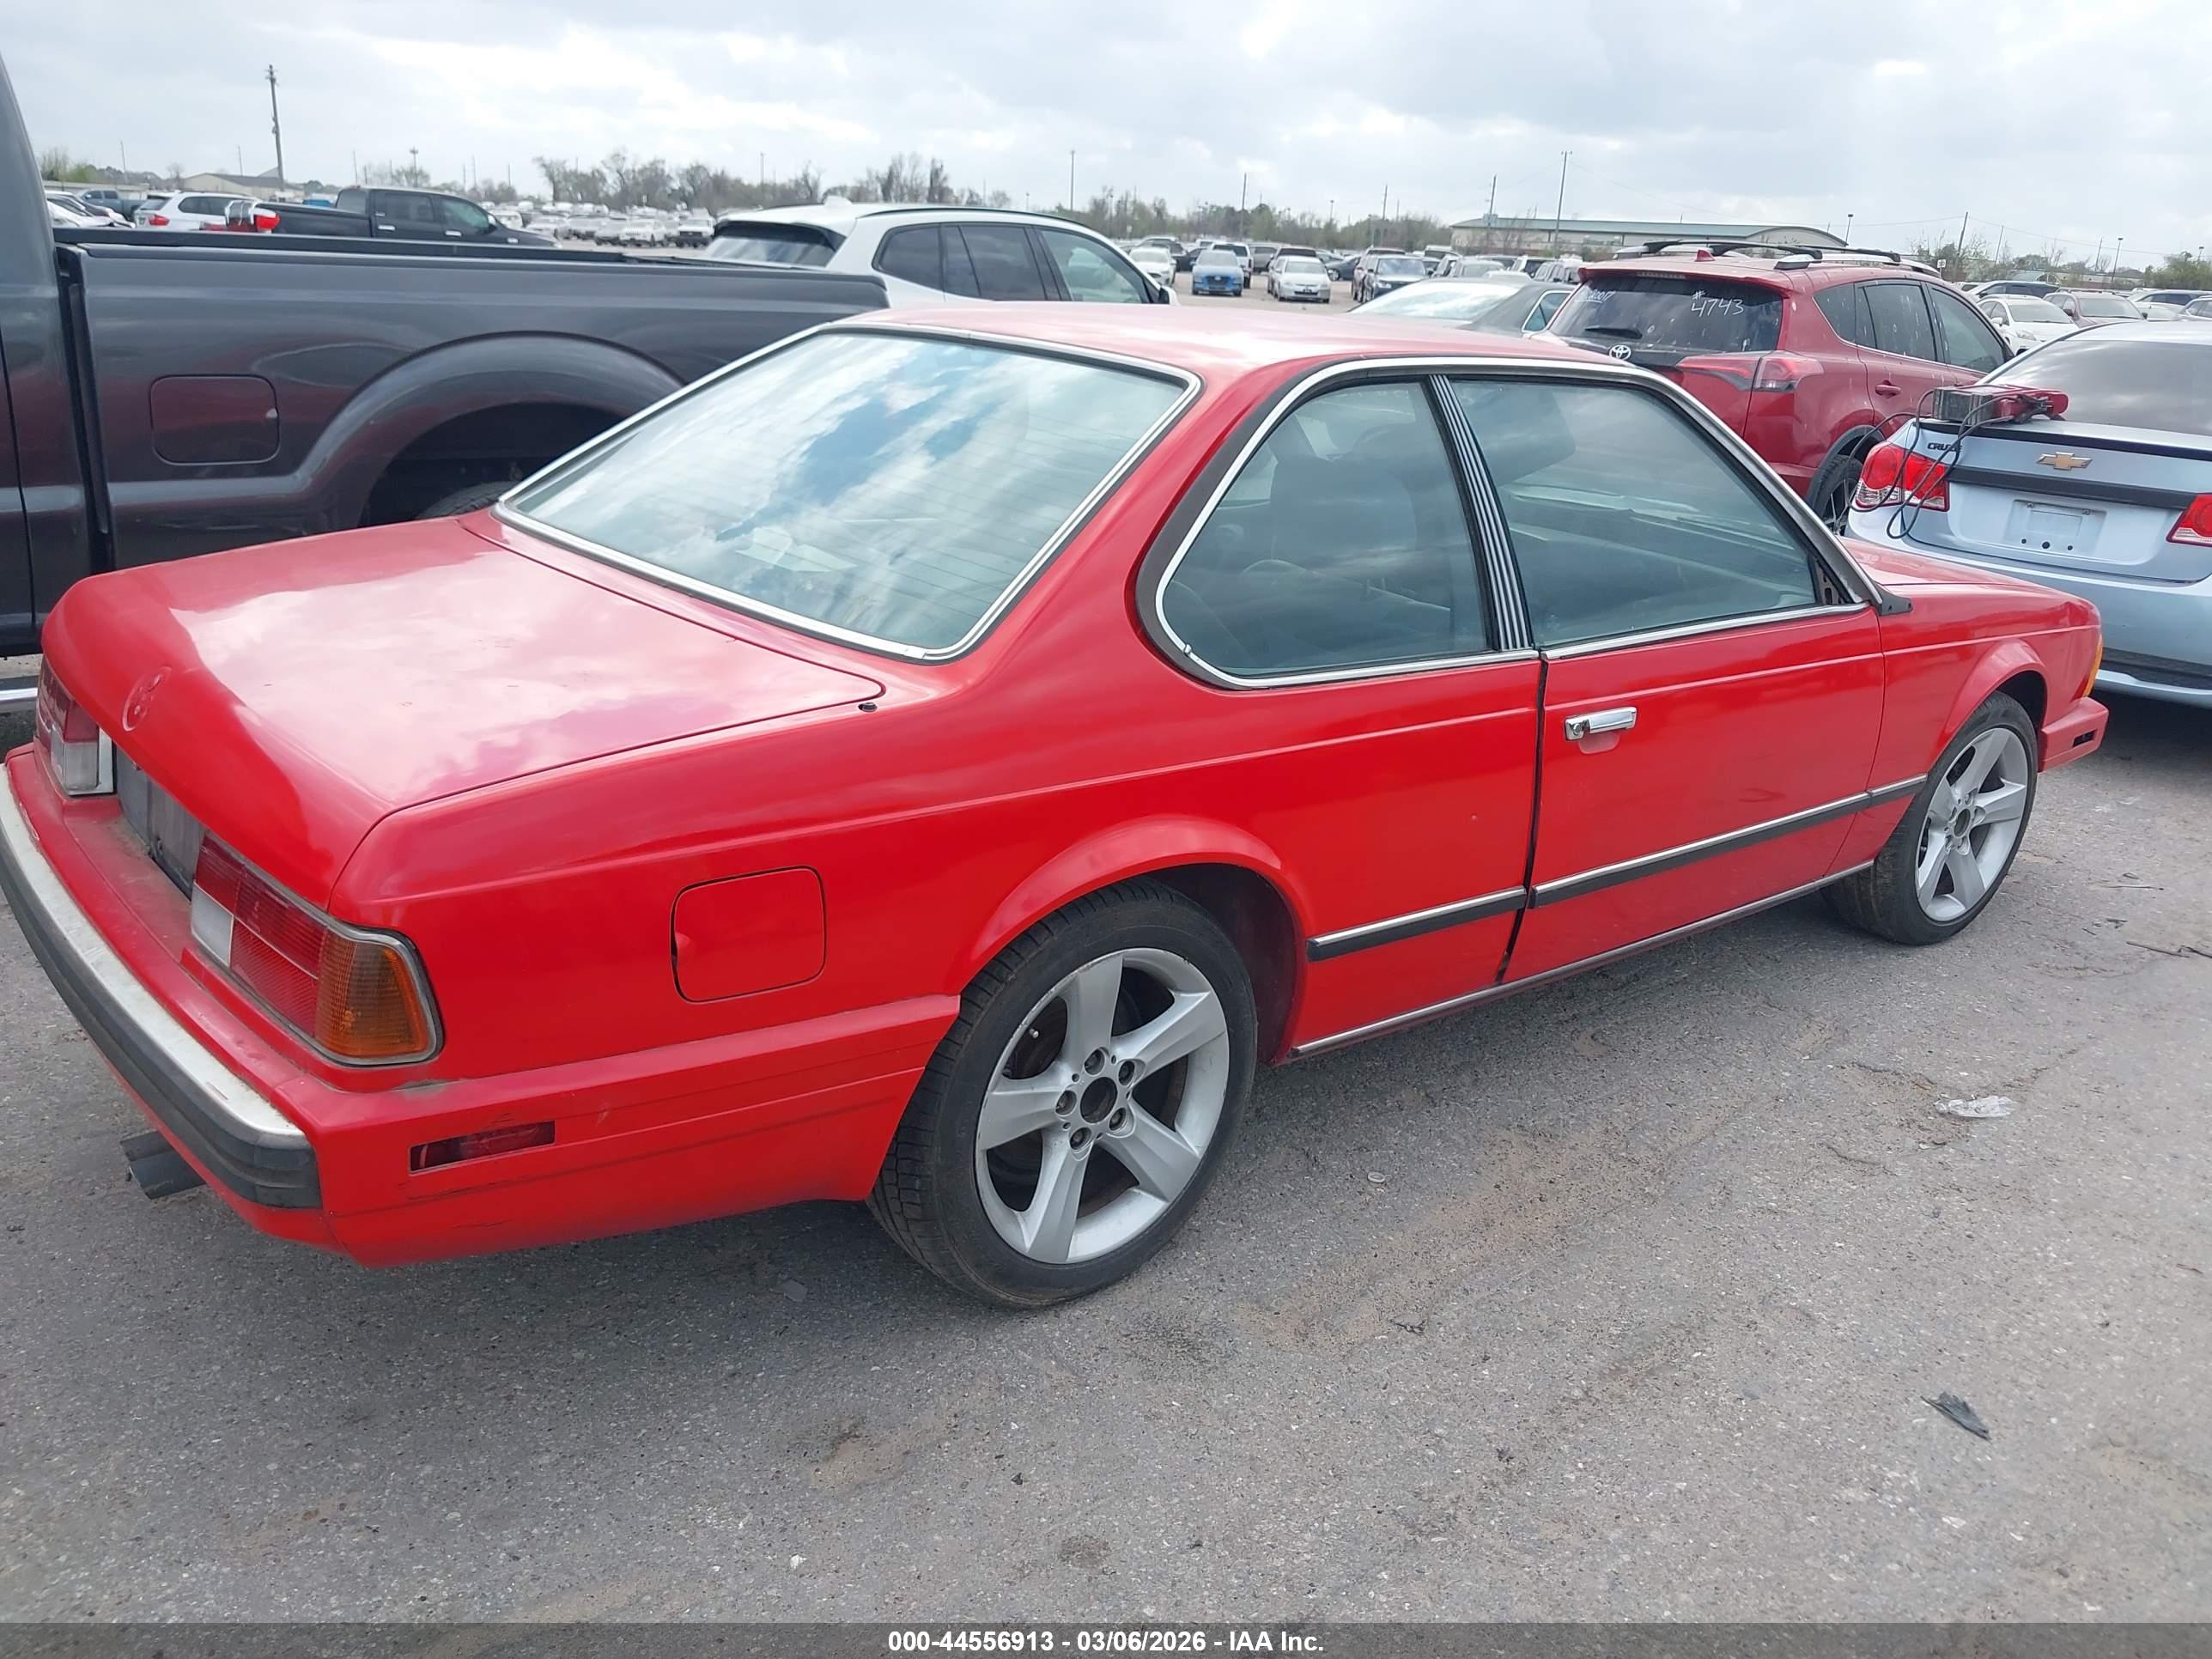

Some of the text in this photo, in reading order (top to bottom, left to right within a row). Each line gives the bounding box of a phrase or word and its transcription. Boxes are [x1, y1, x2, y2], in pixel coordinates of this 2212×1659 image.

[1692, 290, 1705, 301] #
[1691, 297, 1744, 318] 4743
[1927, 442, 1963, 453] CRU
